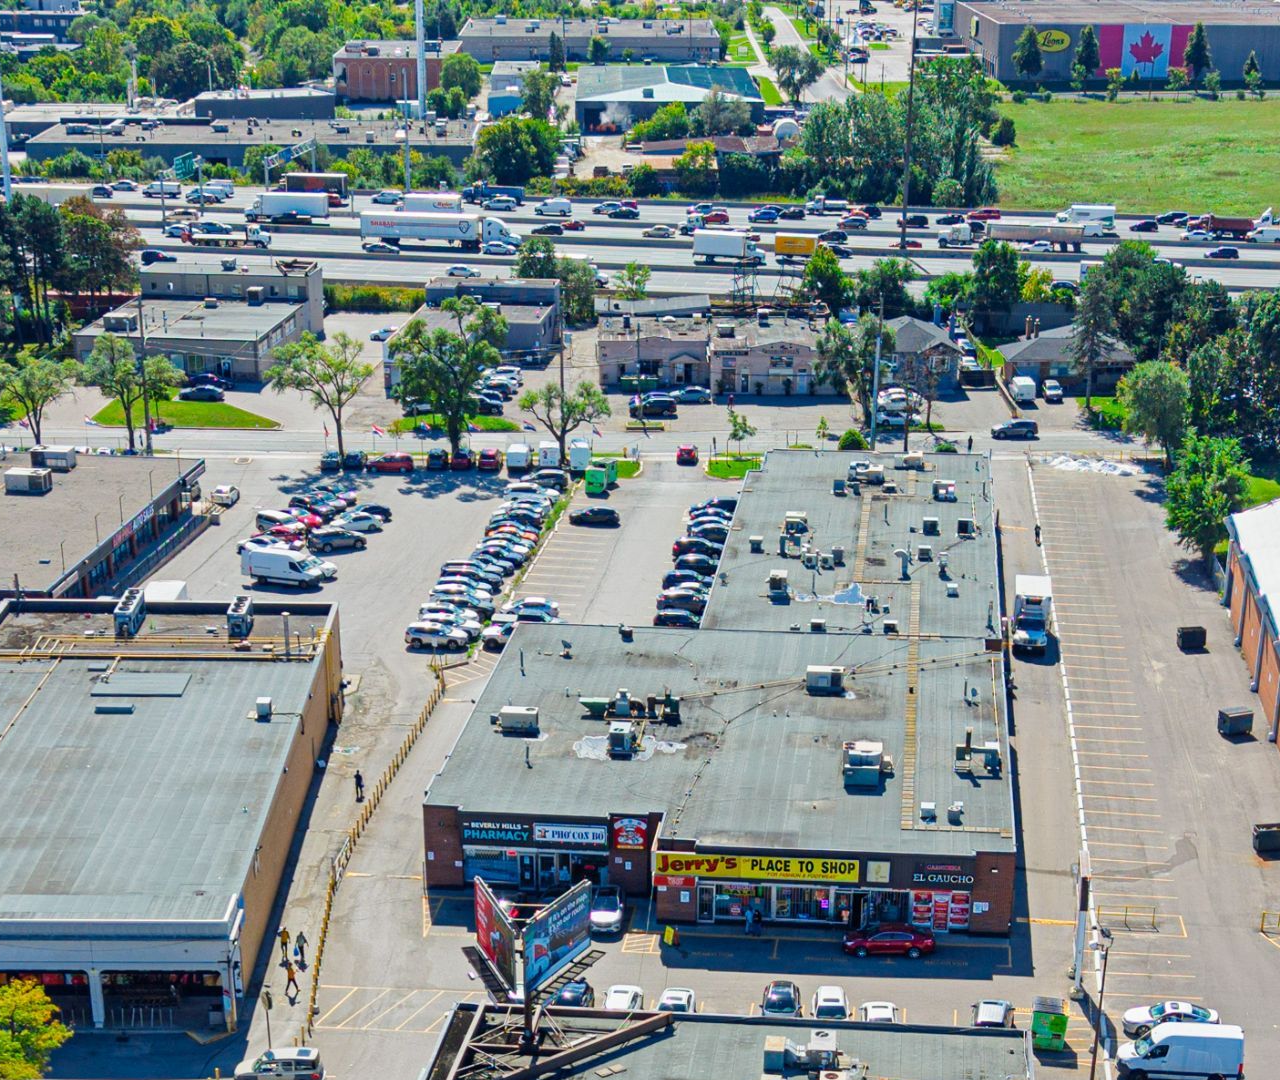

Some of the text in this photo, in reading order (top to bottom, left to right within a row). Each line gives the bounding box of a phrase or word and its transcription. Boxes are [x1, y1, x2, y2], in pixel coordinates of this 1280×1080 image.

[470, 821, 500, 829] BEVERLY
[464, 829, 529, 842] PHARMACY
[658, 854, 738, 873] Jerry's
[751, 858, 791, 872] PLACE
[798, 860, 815, 873] TO
[821, 861, 856, 875] SHOP
[913, 873, 974, 884] EL GAUCHO
